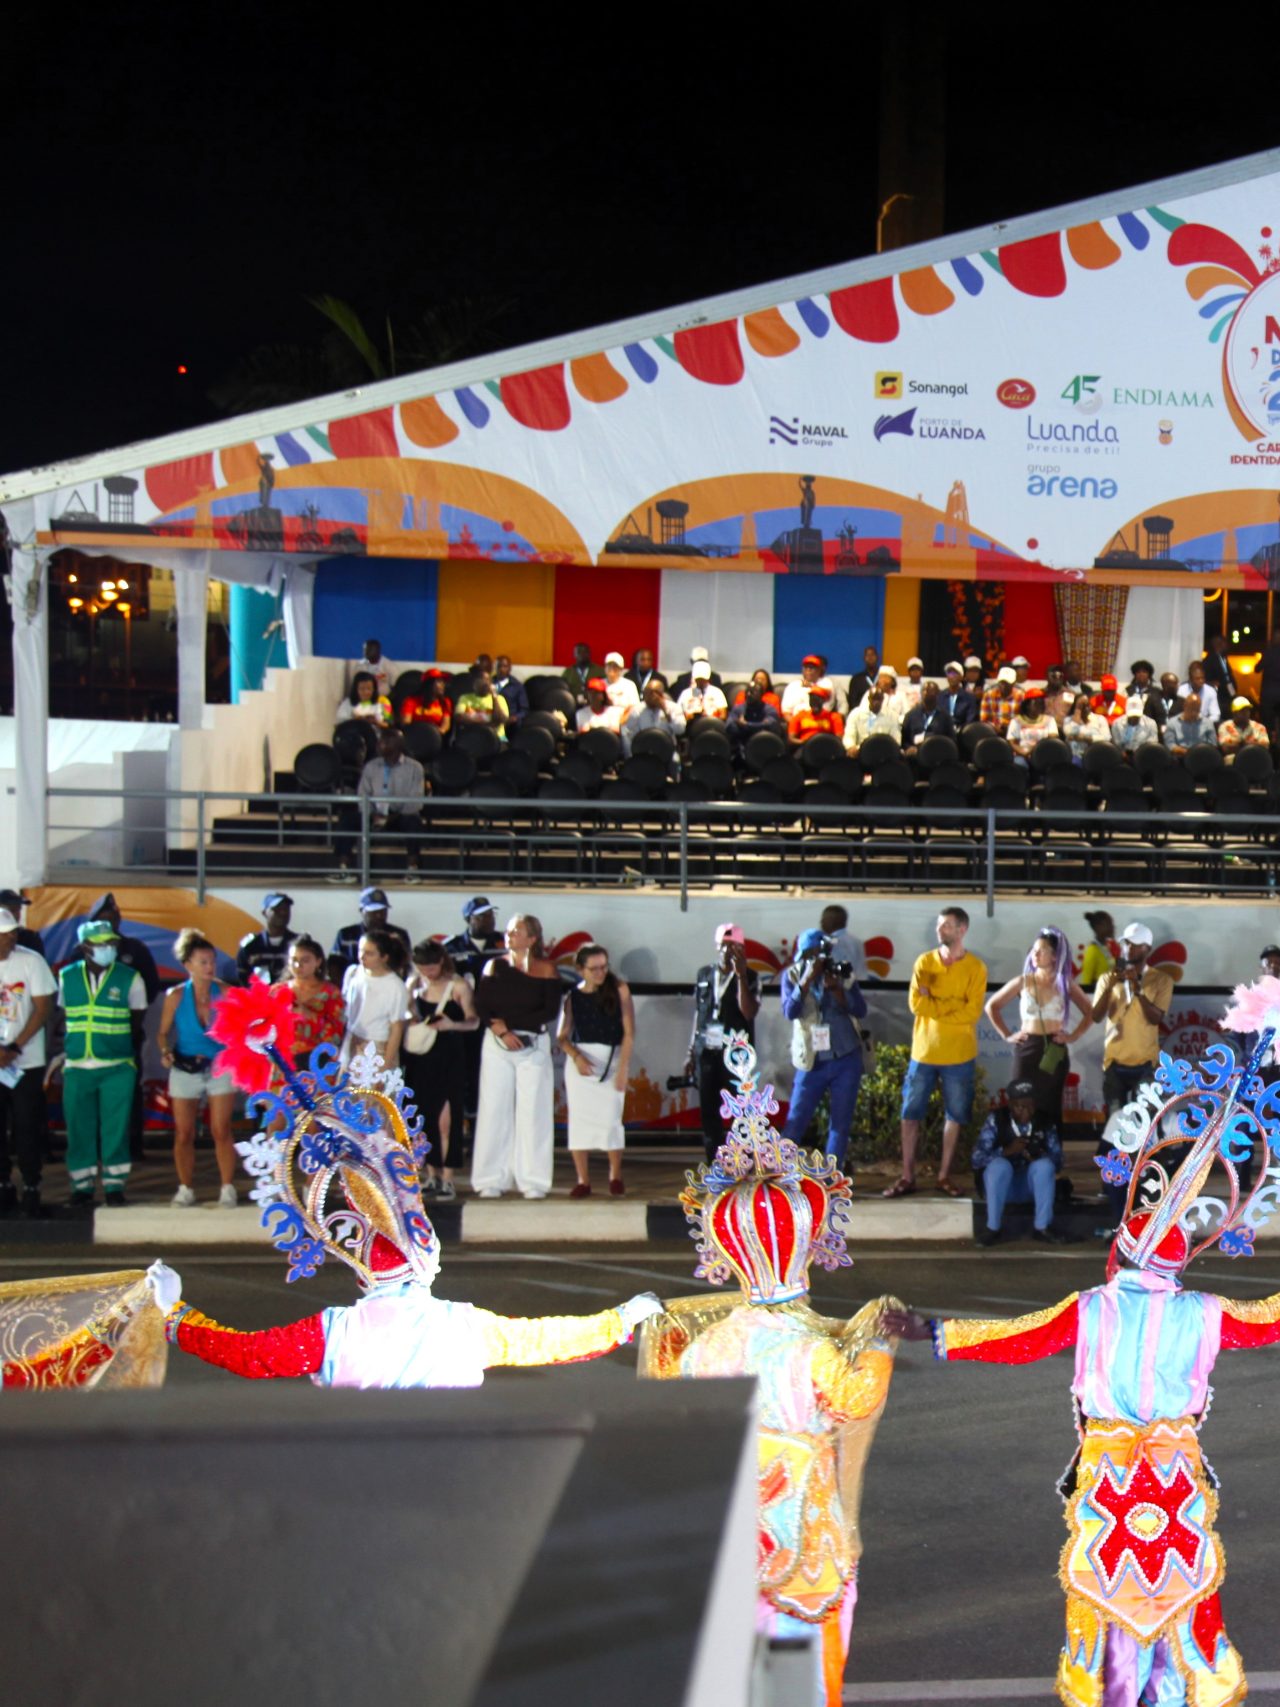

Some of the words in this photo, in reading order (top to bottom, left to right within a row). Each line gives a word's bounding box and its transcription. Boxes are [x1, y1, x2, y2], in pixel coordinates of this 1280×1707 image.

[908, 380, 969, 397] Sonangol
[1061, 375, 1102, 412] 45
[1113, 387, 1215, 408] ENDIAMA
[919, 418, 948, 426] PORTO
[802, 424, 849, 438] NAVAL
[919, 427, 986, 440] LUANDA
[1027, 415, 1120, 443] Luanda
[802, 437, 833, 447] Grupo
[1027, 443, 1079, 454] Precisa
[1084, 444, 1100, 454] de
[1027, 464, 1061, 475] grupo
[1027, 474, 1118, 499] arena
[1180, 1032, 1208, 1043] CAR
[1173, 1044, 1209, 1056] NAV
